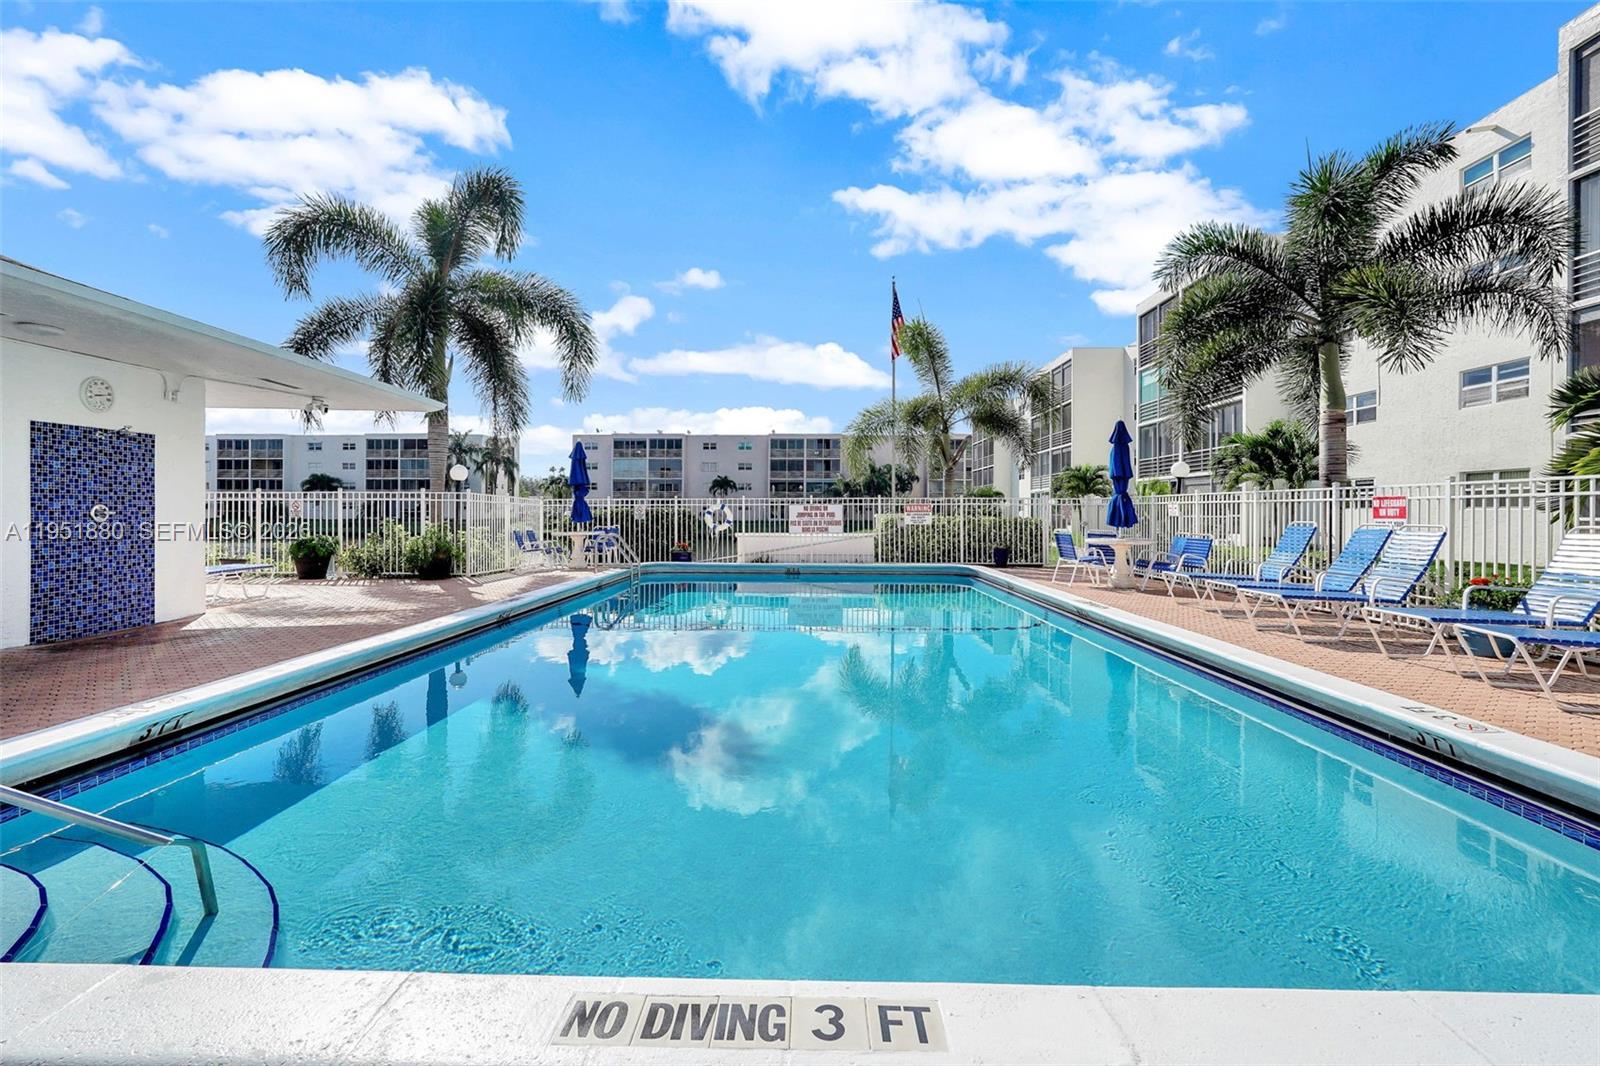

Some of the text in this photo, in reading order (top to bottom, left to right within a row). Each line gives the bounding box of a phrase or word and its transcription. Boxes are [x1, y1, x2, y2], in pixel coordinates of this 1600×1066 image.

[560, 1000, 931, 1044] NO DIVING 3 FT
